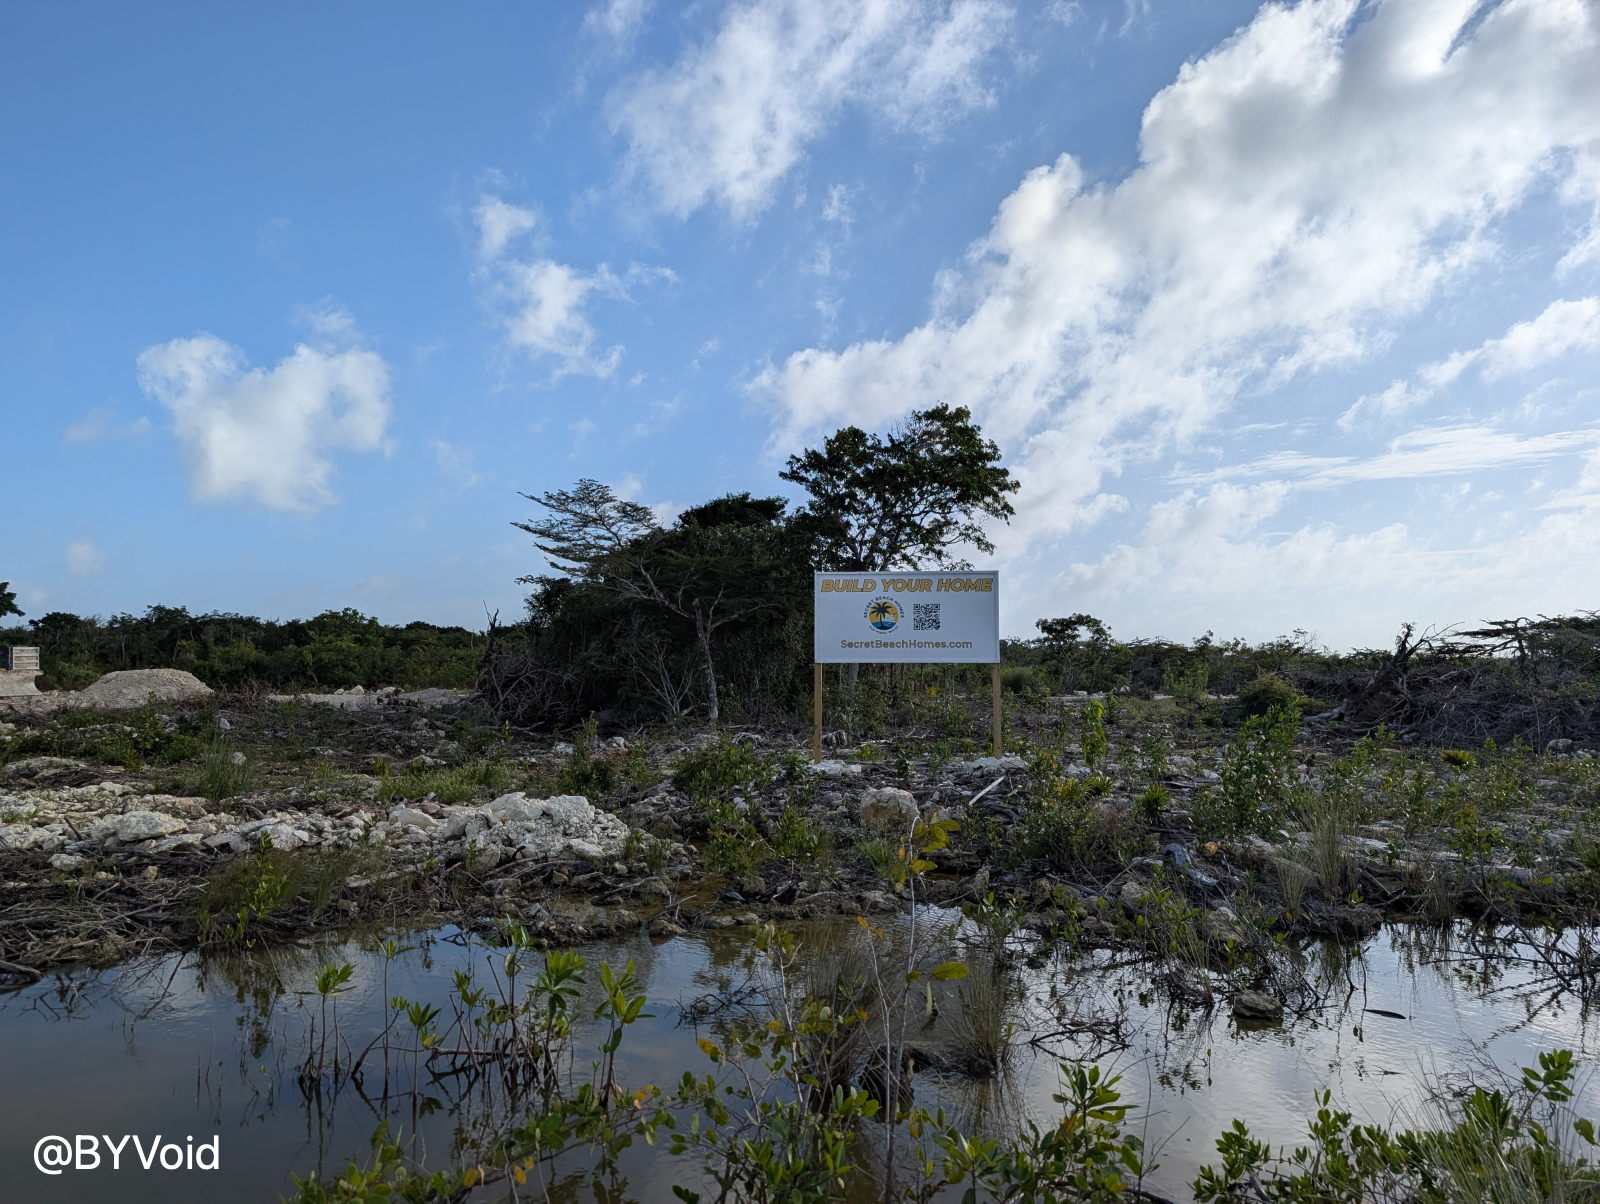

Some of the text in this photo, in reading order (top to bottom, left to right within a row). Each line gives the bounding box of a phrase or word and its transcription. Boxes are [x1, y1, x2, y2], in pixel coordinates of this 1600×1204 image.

[820, 577, 993, 593] BUILD YOUR HOME
[894, 600, 905, 618] HOMES
[840, 639, 973, 649] SecretBeachHomes.com
